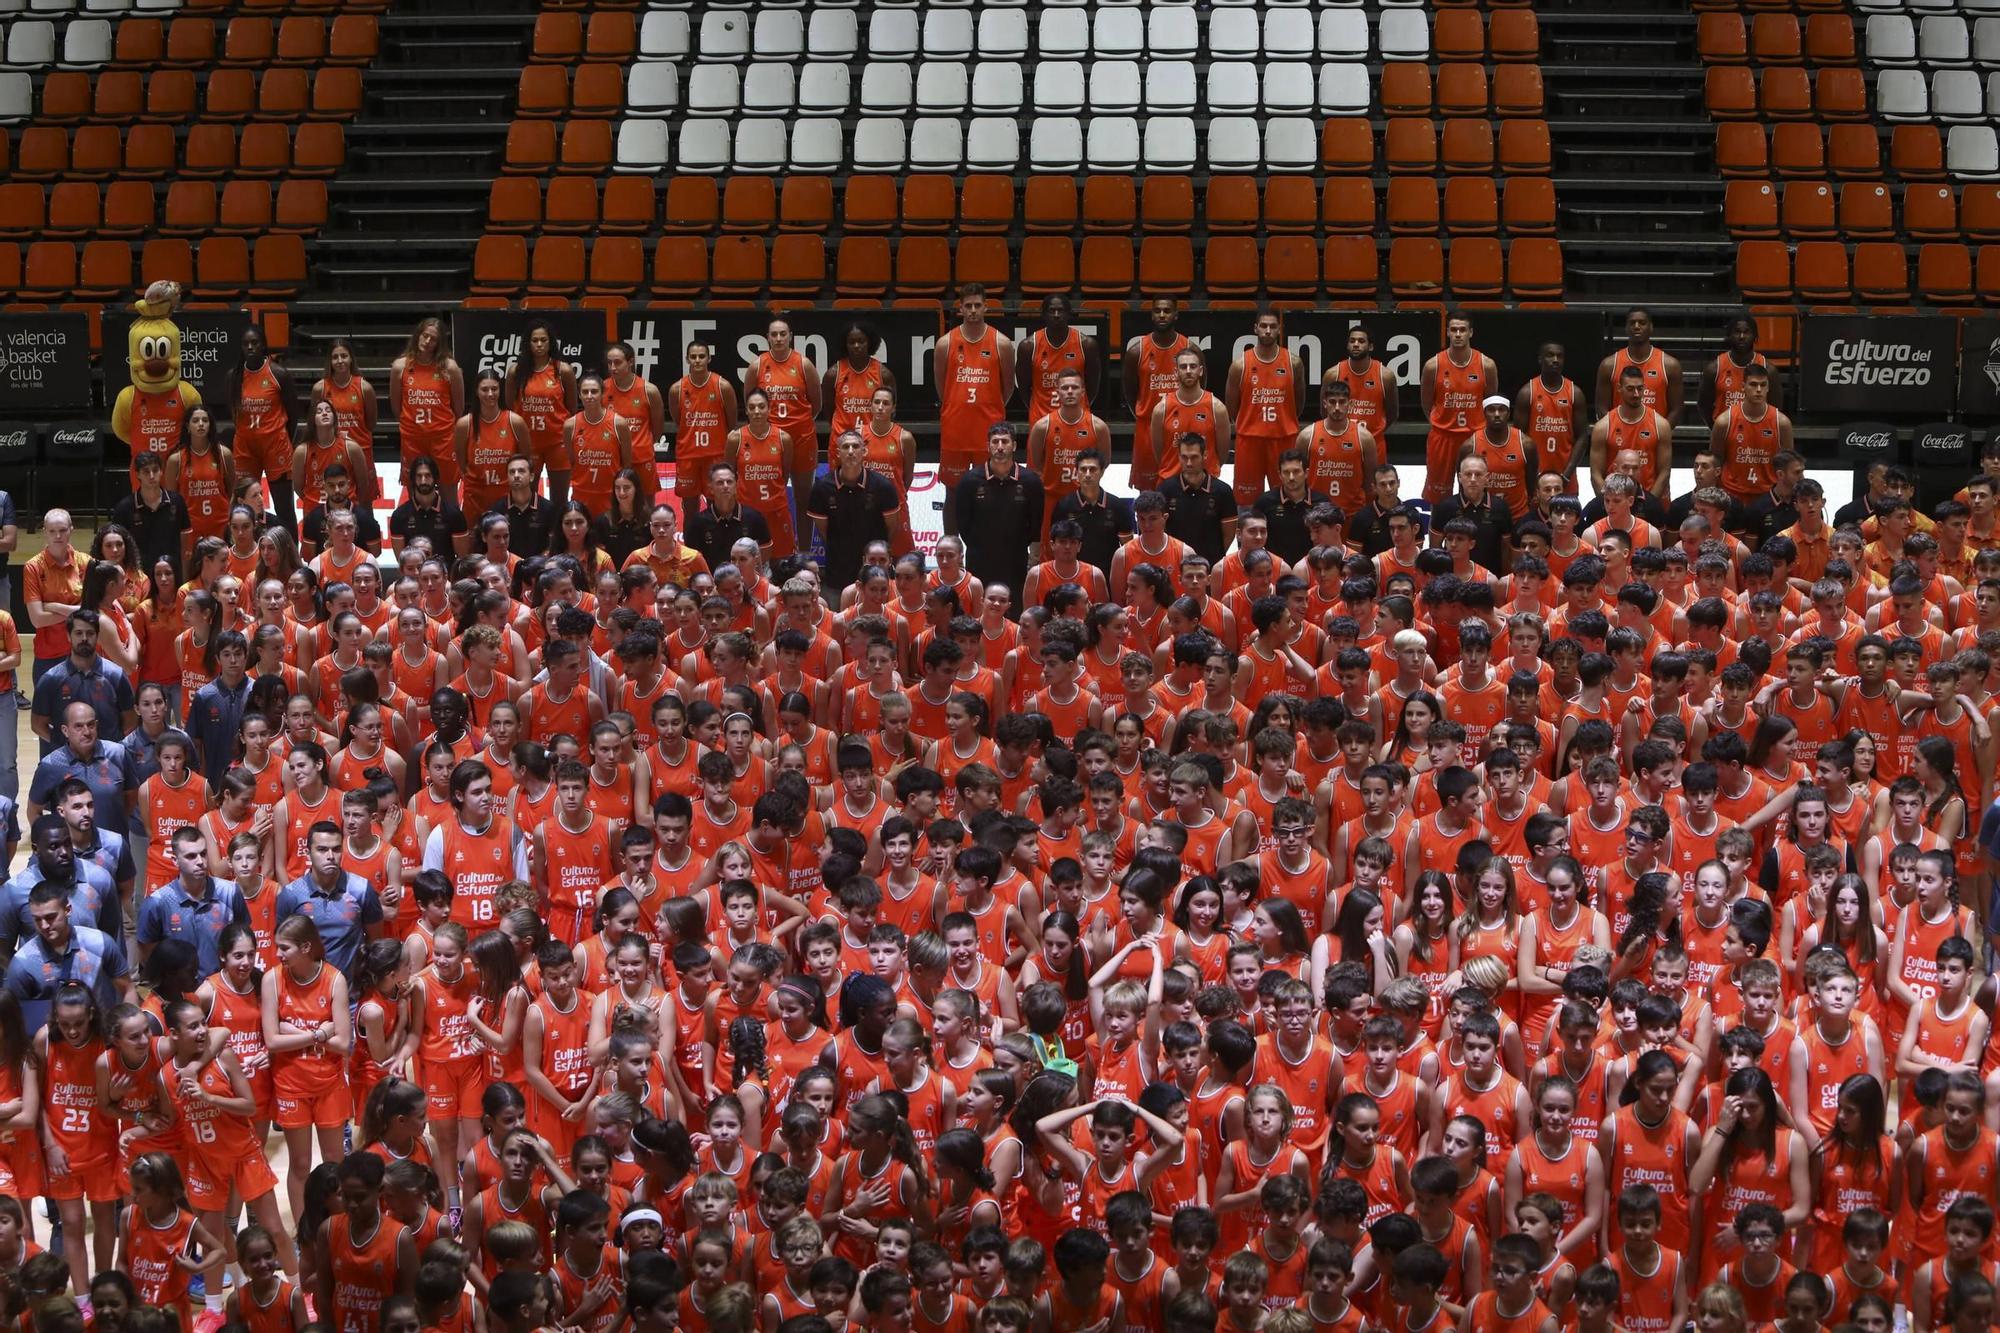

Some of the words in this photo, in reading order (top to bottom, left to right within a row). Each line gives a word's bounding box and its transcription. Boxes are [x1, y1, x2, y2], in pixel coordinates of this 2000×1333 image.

[8, 328, 66, 345] valencia
[180, 326, 228, 344] alencia
[9, 347, 57, 363] basket
[180, 344, 218, 362] asket
[562, 344, 582, 356] del
[1828, 338, 1911, 362] Cultura
[1912, 349, 1932, 362] del
[10, 365, 43, 381] club
[957, 366, 982, 376] Cultura
[1824, 362, 1931, 386] Esfuerzo
[956, 374, 990, 384] Esfuerzo
[408, 389, 434, 398] Cultura
[766, 384, 793, 393] Cultura
[968, 388, 976, 403] 3
[1252, 388, 1278, 396] Cultura
[408, 396, 440, 405] Esfuerzo
[522, 396, 549, 406] Cultura
[1252, 396, 1285, 404] Esfuerzo
[1444, 392, 1472, 400] Cultura
[522, 404, 554, 412] Esfuerzo
[778, 402, 788, 418] 0
[1262, 406, 1276, 422] 16
[141, 418, 170, 427] Cultura
[416, 409, 432, 424] 21
[686, 411, 710, 420] Cultura
[686, 418, 718, 427] Esfuerzo
[1457, 412, 1466, 427] 6
[1536, 416, 1563, 424] Cultura
[141, 426, 176, 434] Esfuerzo
[530, 416, 546, 431] 13
[855, 416, 863, 432] 4
[1536, 424, 1568, 432] Esfuerzo
[53, 428, 96, 444] Coca-Cola
[694, 432, 709, 446] 10
[1846, 431, 1892, 448] Coca-Cola
[1921, 432, 1966, 450] Coca-Cola
[150, 438, 168, 452] 86
[1546, 437, 1556, 452] 0
[474, 448, 504, 456] Cultura
[578, 449, 604, 458] Cultura
[1736, 448, 1764, 456] Cultura
[578, 456, 612, 466] Esfuerzo
[1318, 460, 1346, 468] Cultura
[1736, 455, 1770, 464] Esfuerzo
[744, 464, 773, 472] Cultura
[1316, 468, 1353, 477] Esfuerzo
[485, 470, 500, 485] 14
[590, 468, 598, 483] 7
[744, 472, 778, 480] Esfuerzo
[1748, 468, 1758, 484] 4
[760, 485, 770, 500] 5
[1330, 481, 1340, 496] 8
[202, 500, 212, 515] 6
[158, 818, 188, 828] Cultura
[458, 872, 494, 882] Cultura
[561, 866, 593, 876] Cultura
[562, 876, 600, 888] Esfuerzo
[471, 900, 492, 920] 18
[1065, 1022, 1083, 1040] 10
[54, 1082, 93, 1094] Cultura
[62, 1108, 90, 1132] 23
[190, 1120, 216, 1142] 18
[1624, 1166, 1664, 1180] Cultura
[134, 1257, 166, 1271] Cultura
[334, 1281, 376, 1298] Cultura
[1624, 1315, 1662, 1329] Cultura
